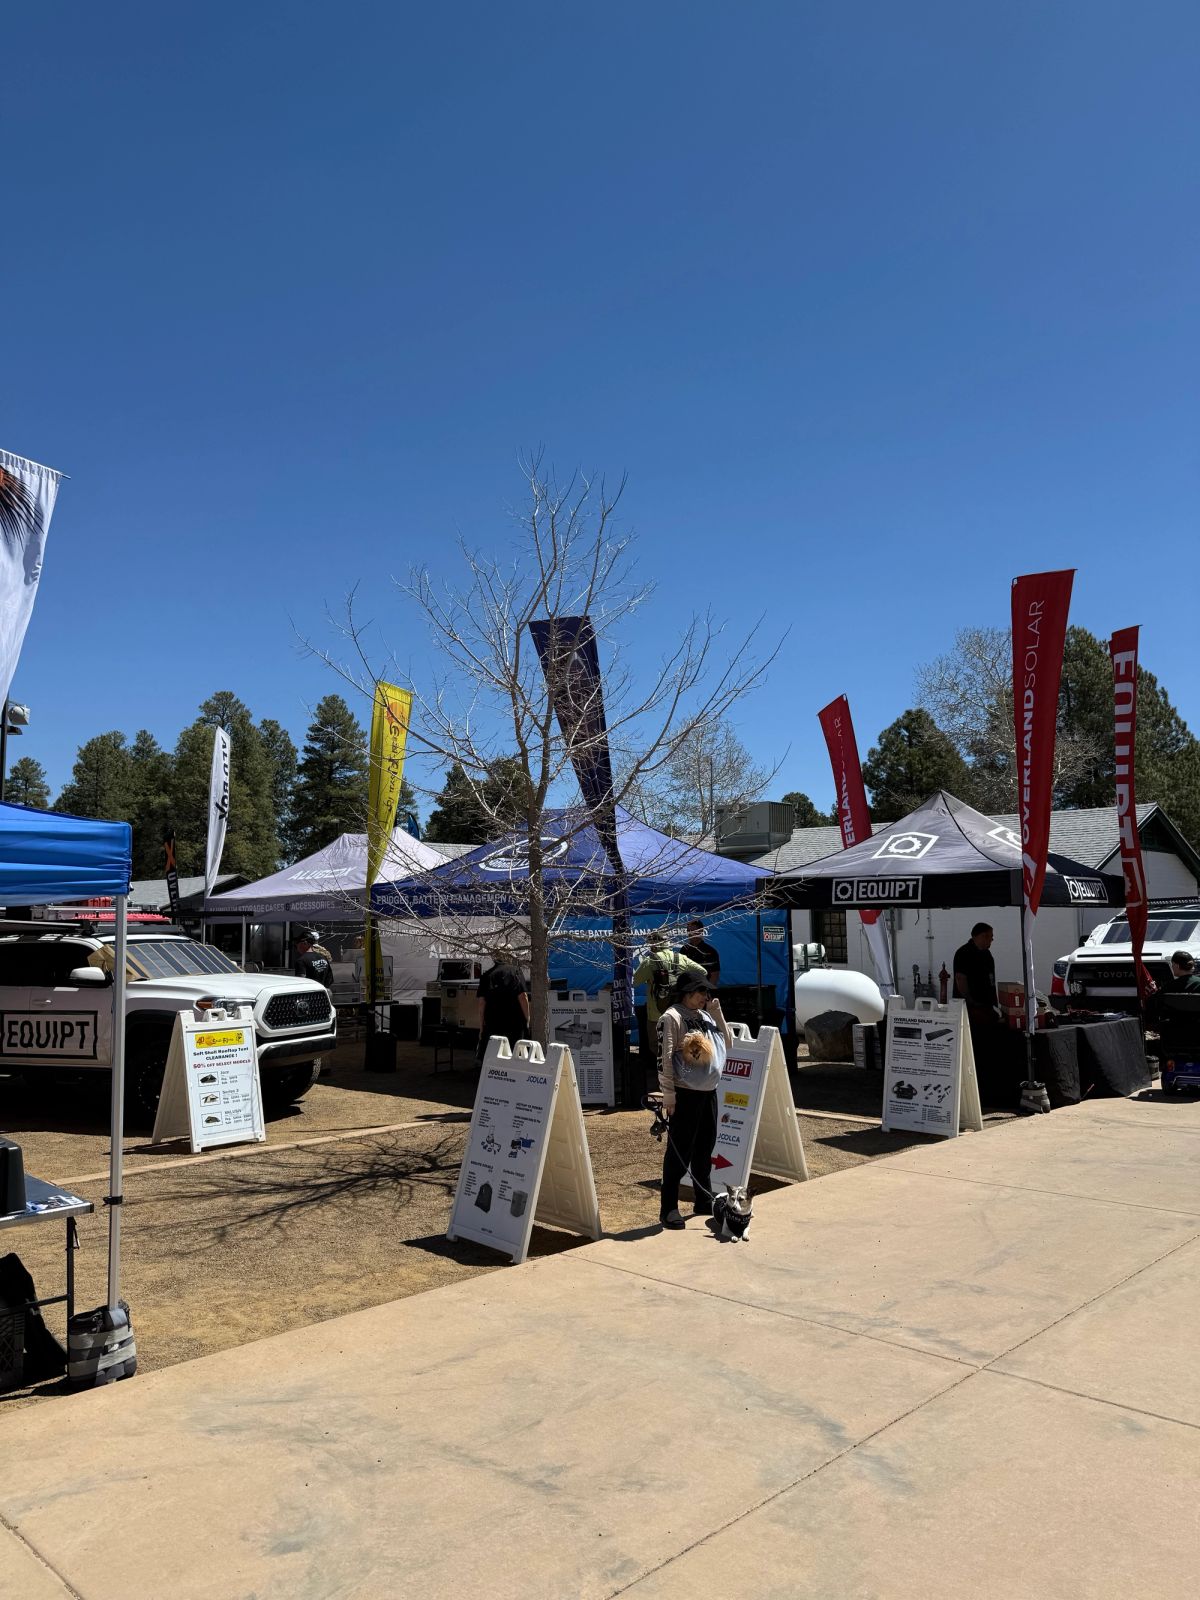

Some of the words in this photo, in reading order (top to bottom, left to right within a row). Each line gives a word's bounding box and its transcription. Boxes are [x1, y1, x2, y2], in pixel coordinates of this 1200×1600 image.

[858, 880, 917, 898] EQUIPT
[265, 903, 285, 912] CASES
[291, 901, 336, 911] ACCESSORIES
[6, 1020, 90, 1049] EQUIPT
[205, 1053, 235, 1061] CLEARANCE
[488, 1069, 508, 1077] JOOLCA
[526, 1075, 547, 1085] JOOLCA
